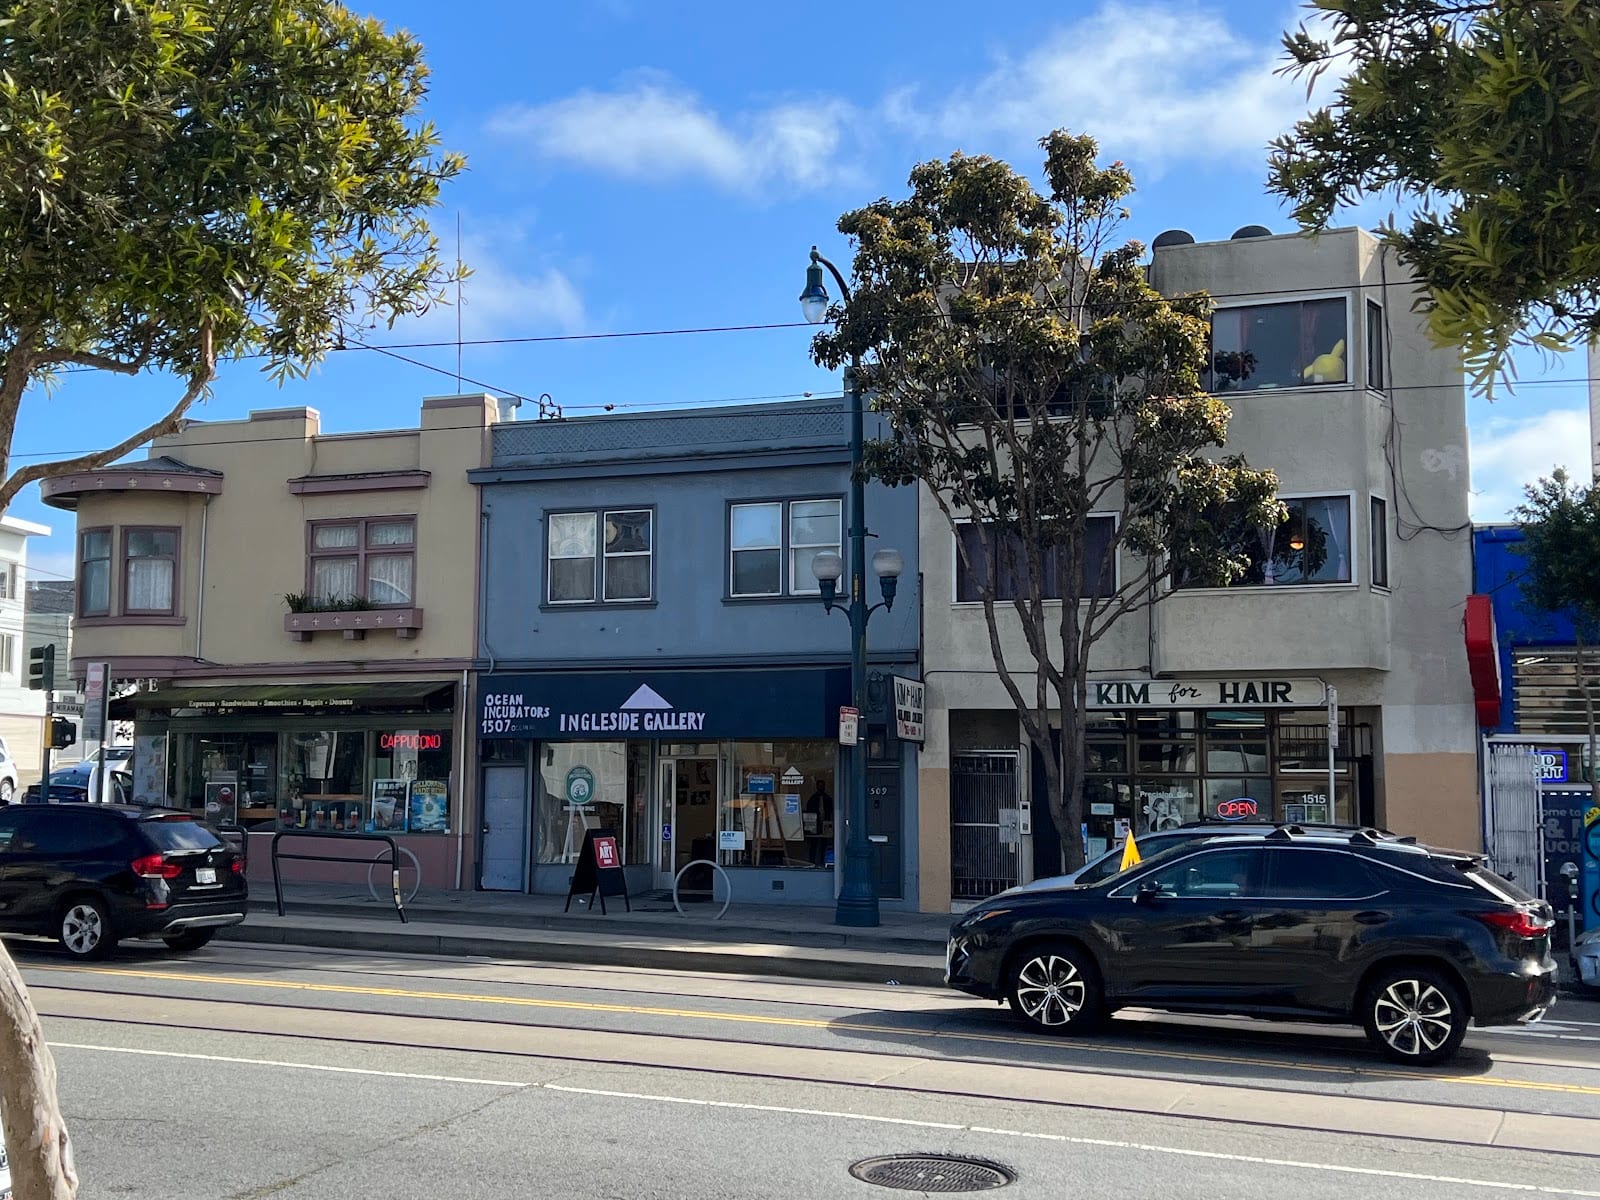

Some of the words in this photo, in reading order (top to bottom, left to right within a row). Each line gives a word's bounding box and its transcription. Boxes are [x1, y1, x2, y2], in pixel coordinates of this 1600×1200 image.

[109, 678, 159, 692] CAFE
[1096, 682, 1151, 704] KIM
[1168, 683, 1202, 704] for
[1219, 681, 1294, 704] HAIR
[188, 700, 216, 708] Espresso
[302, 699, 323, 707] Bagels
[329, 698, 354, 706] Donuts
[485, 694, 523, 706] OCEAN
[484, 706, 550, 719] INCUBATORS
[481, 719, 511, 734] 1507
[559, 713, 640, 732] INGLESIDE
[644, 712, 706, 731] GALLERY
[1176, 790, 1193, 798] Cuts
[1301, 794, 1326, 804] 1515
[1217, 802, 1257, 816] OPEN
[1545, 840, 1582, 853] UOR
